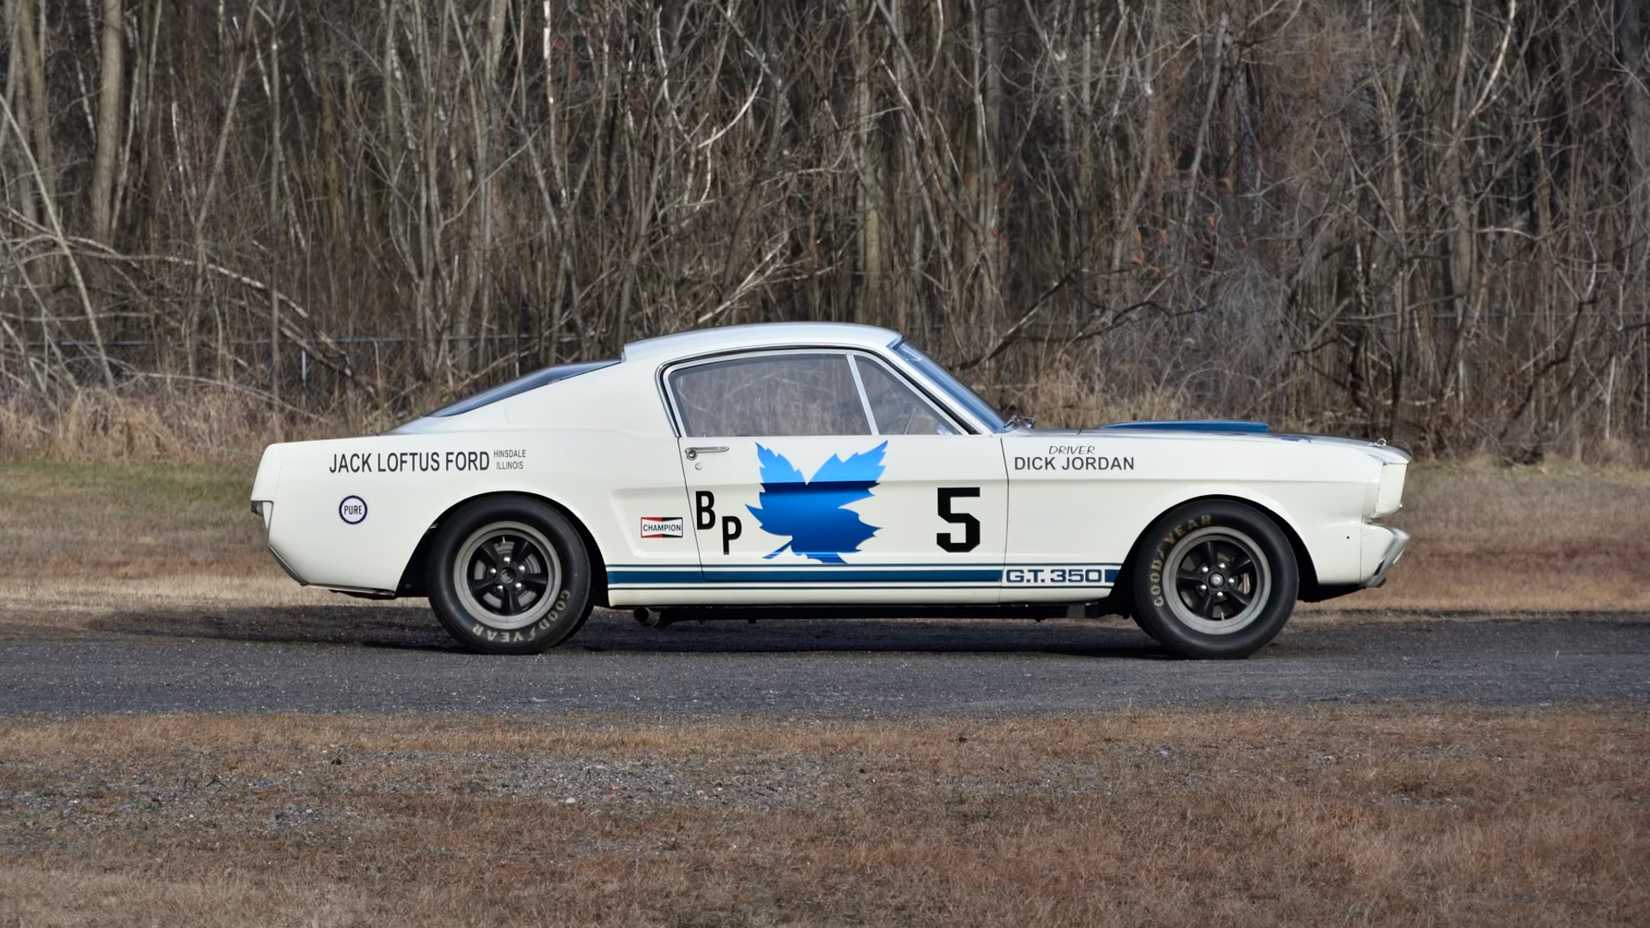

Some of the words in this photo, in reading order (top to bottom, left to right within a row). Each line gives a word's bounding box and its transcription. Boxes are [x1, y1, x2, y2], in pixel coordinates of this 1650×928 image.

[1048, 445, 1095, 455] DRIVER
[329, 453, 372, 473] JACK
[377, 452, 440, 472] LOFTUS
[446, 451, 490, 471] FORD
[1014, 456, 1056, 470] DICK
[1062, 456, 1135, 470] JORDAN
[344, 505, 363, 515] PURE
[936, 487, 981, 553] 5
[643, 524, 681, 532] CHAMPION
